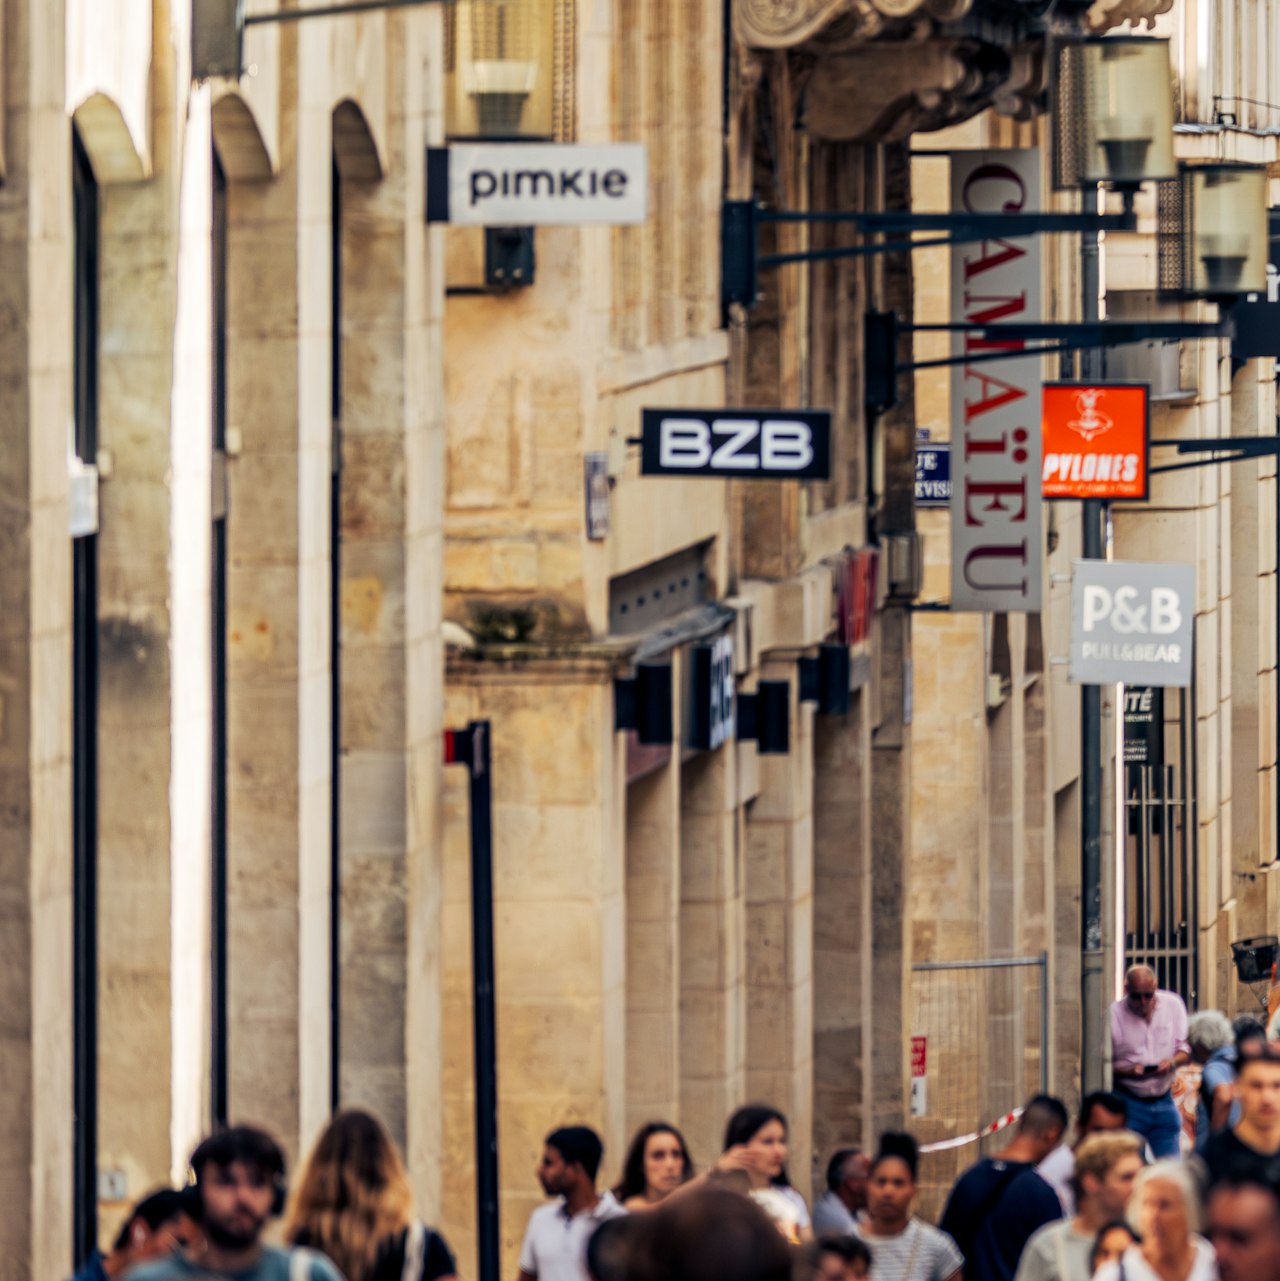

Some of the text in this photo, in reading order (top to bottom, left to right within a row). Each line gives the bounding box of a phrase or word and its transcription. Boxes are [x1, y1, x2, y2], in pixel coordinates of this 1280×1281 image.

[469, 168, 629, 207] pimkie
[659, 417, 814, 471] BZB
[1042, 452, 1140, 483] PYLONES
[1082, 584, 1183, 635] P&B
[1082, 640, 1182, 664] PULL&BEAR
